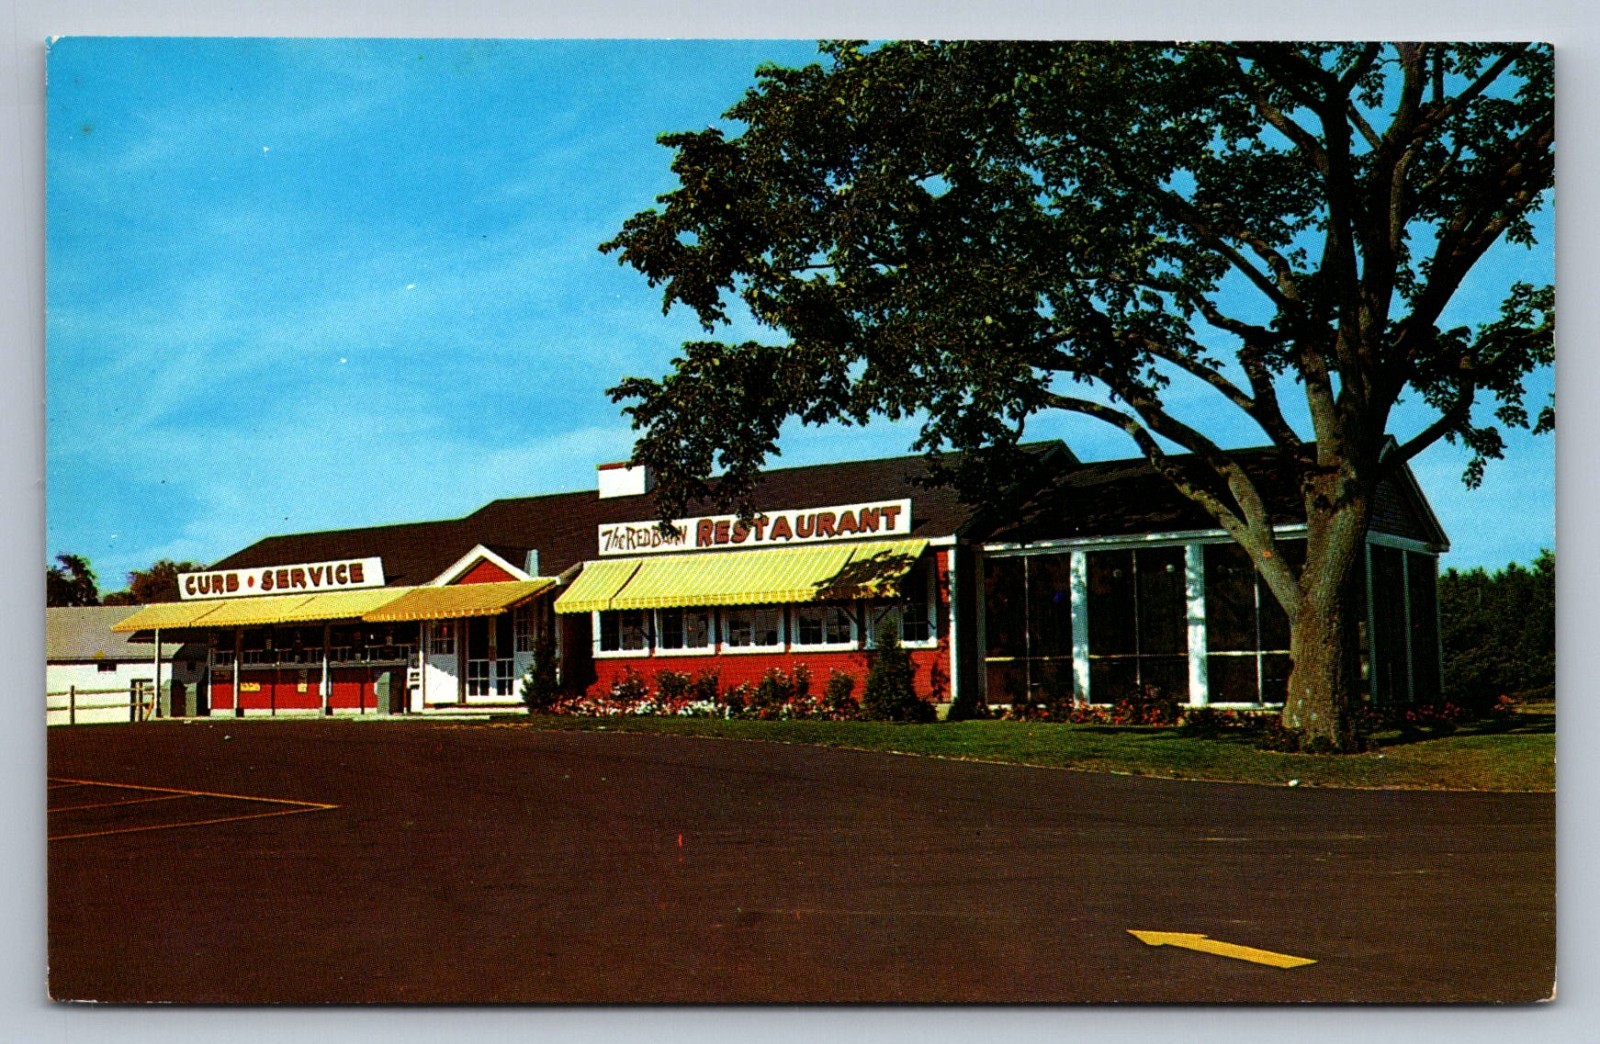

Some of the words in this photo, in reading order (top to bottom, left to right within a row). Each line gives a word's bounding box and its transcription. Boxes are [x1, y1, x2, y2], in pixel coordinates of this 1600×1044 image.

[602, 526, 625, 551] The
[696, 505, 901, 547] RESTAURANT
[185, 573, 240, 596] CURB
[260, 562, 365, 591] SERVICE
